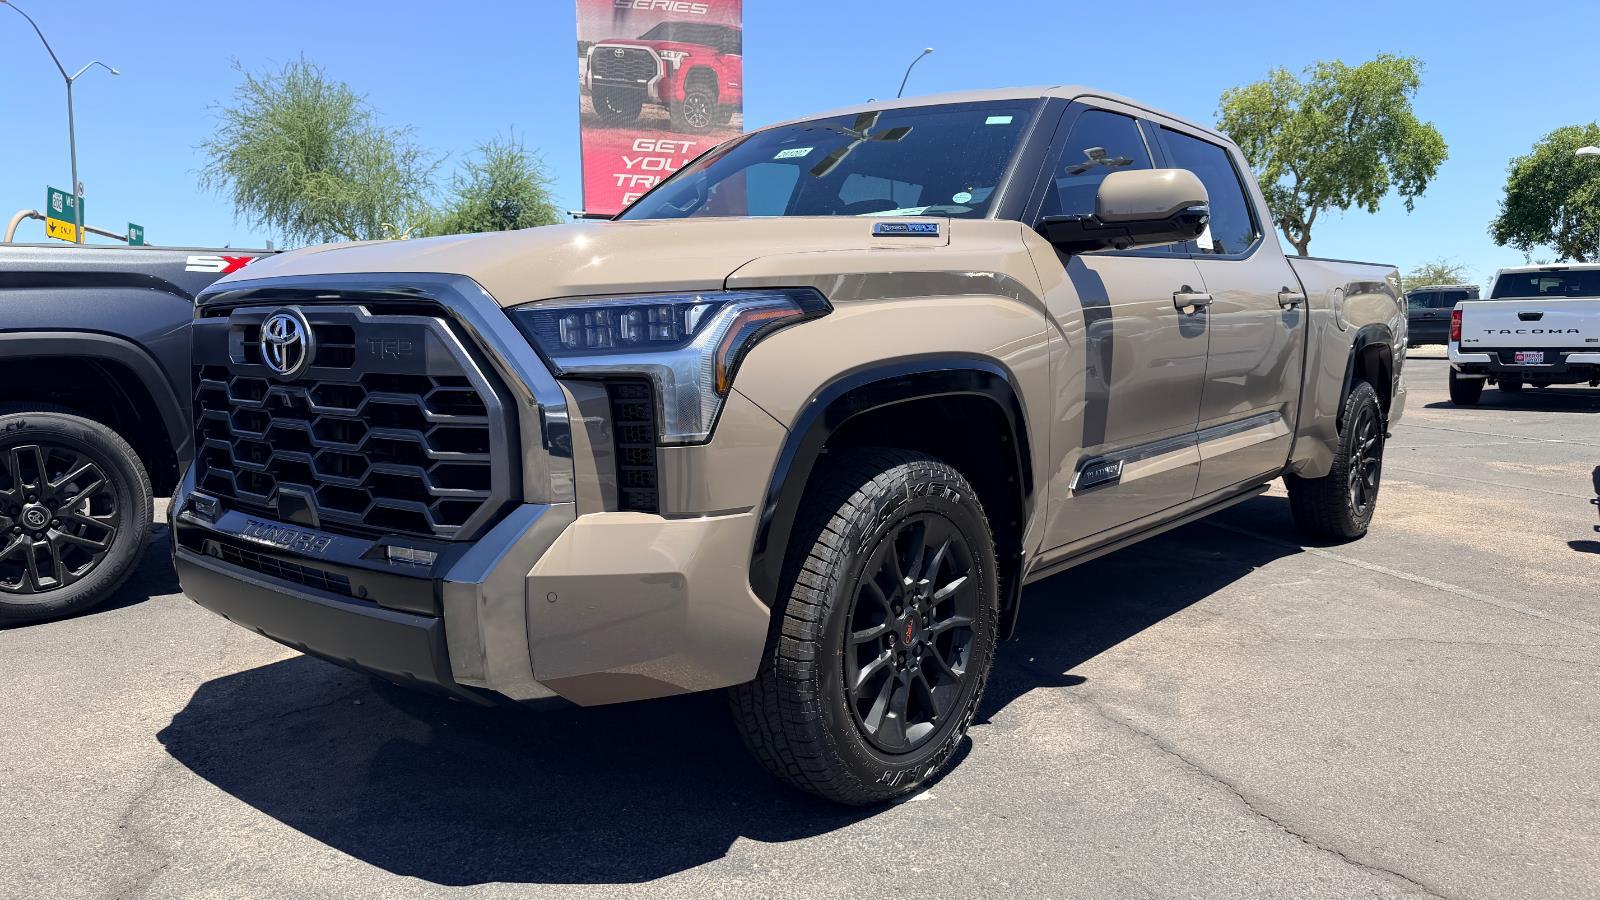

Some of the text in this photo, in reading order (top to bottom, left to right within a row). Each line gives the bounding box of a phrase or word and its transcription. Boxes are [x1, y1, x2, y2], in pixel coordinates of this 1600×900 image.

[614, 0, 709, 15] SERIES
[632, 138, 697, 154] GET
[621, 155, 690, 171] YOU
[366, 337, 412, 359] TRD
[243, 519, 332, 552] TUNDRA
